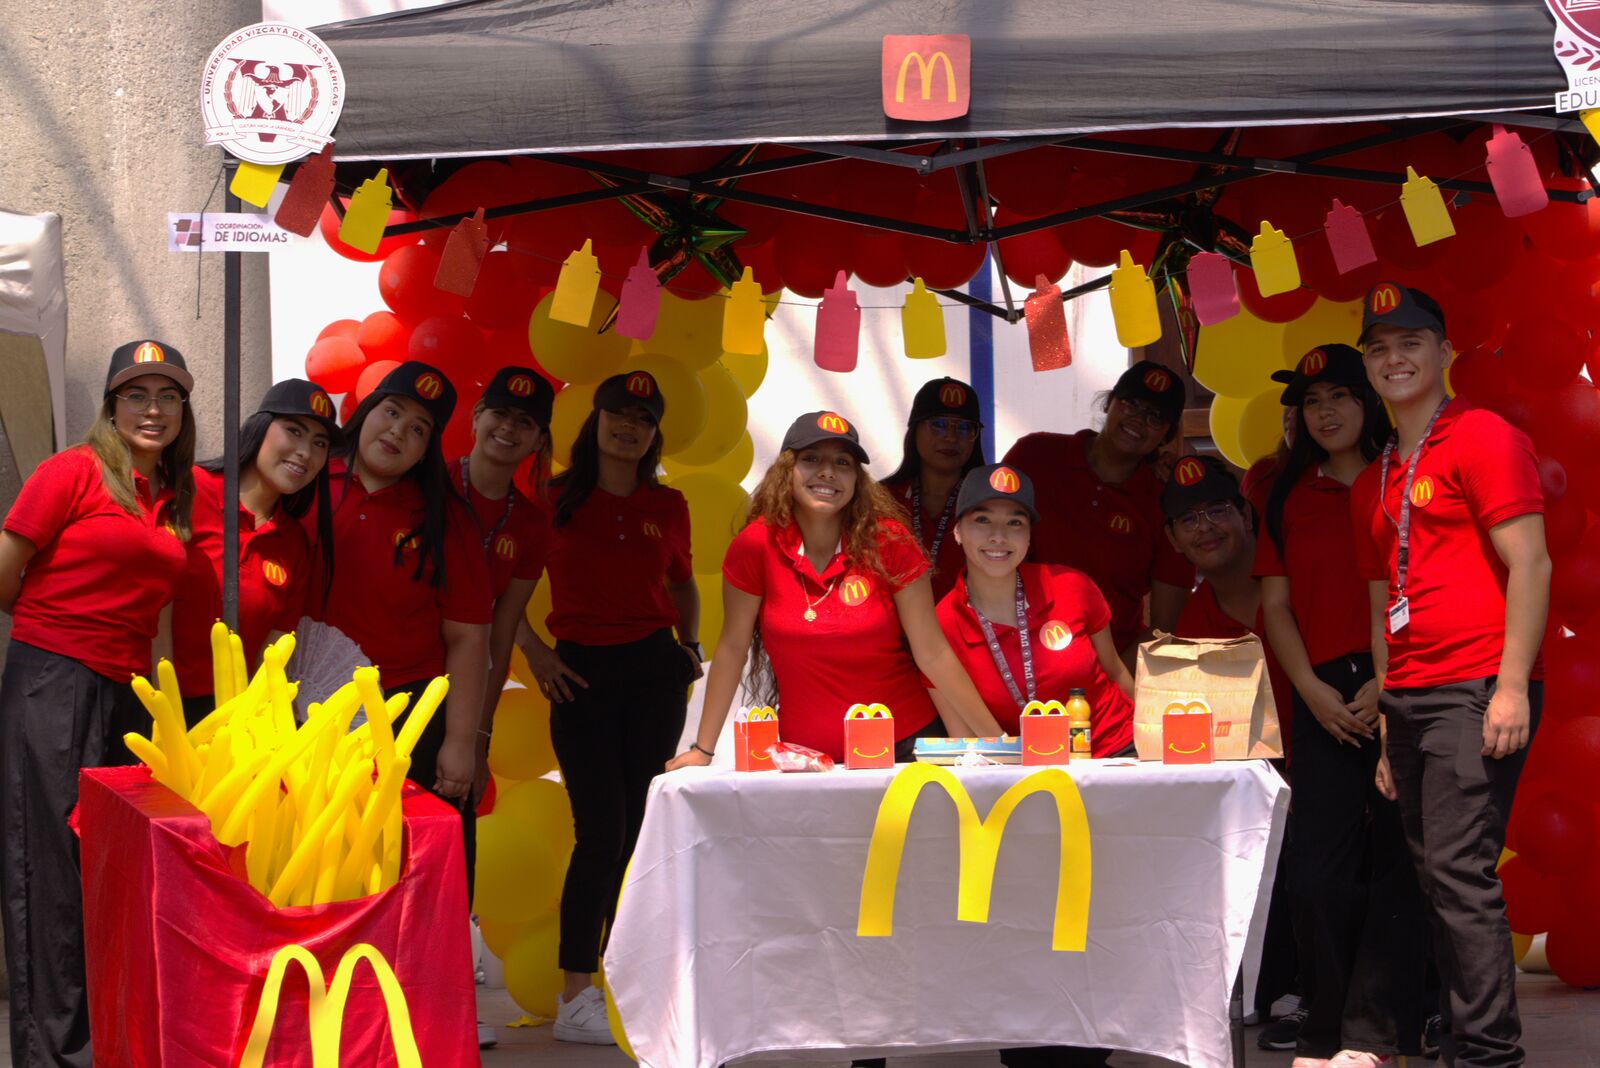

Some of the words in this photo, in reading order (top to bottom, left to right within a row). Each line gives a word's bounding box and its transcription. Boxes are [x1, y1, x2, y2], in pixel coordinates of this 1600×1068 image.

[204, 35, 243, 95] UNIVERSIDAD
[245, 27, 289, 37] VIZCAYA
[292, 30, 305, 41] DE
[306, 39, 323, 55] LAS
[322, 56, 339, 106] AMÉRICAS
[1559, 90, 1597, 111] EDU
[214, 231, 228, 242] DE
[232, 231, 288, 243] IDIOMAS
[1016, 600, 1026, 617] UVA
[1019, 628, 1030, 648] UVA
[1023, 660, 1033, 679] UVA
